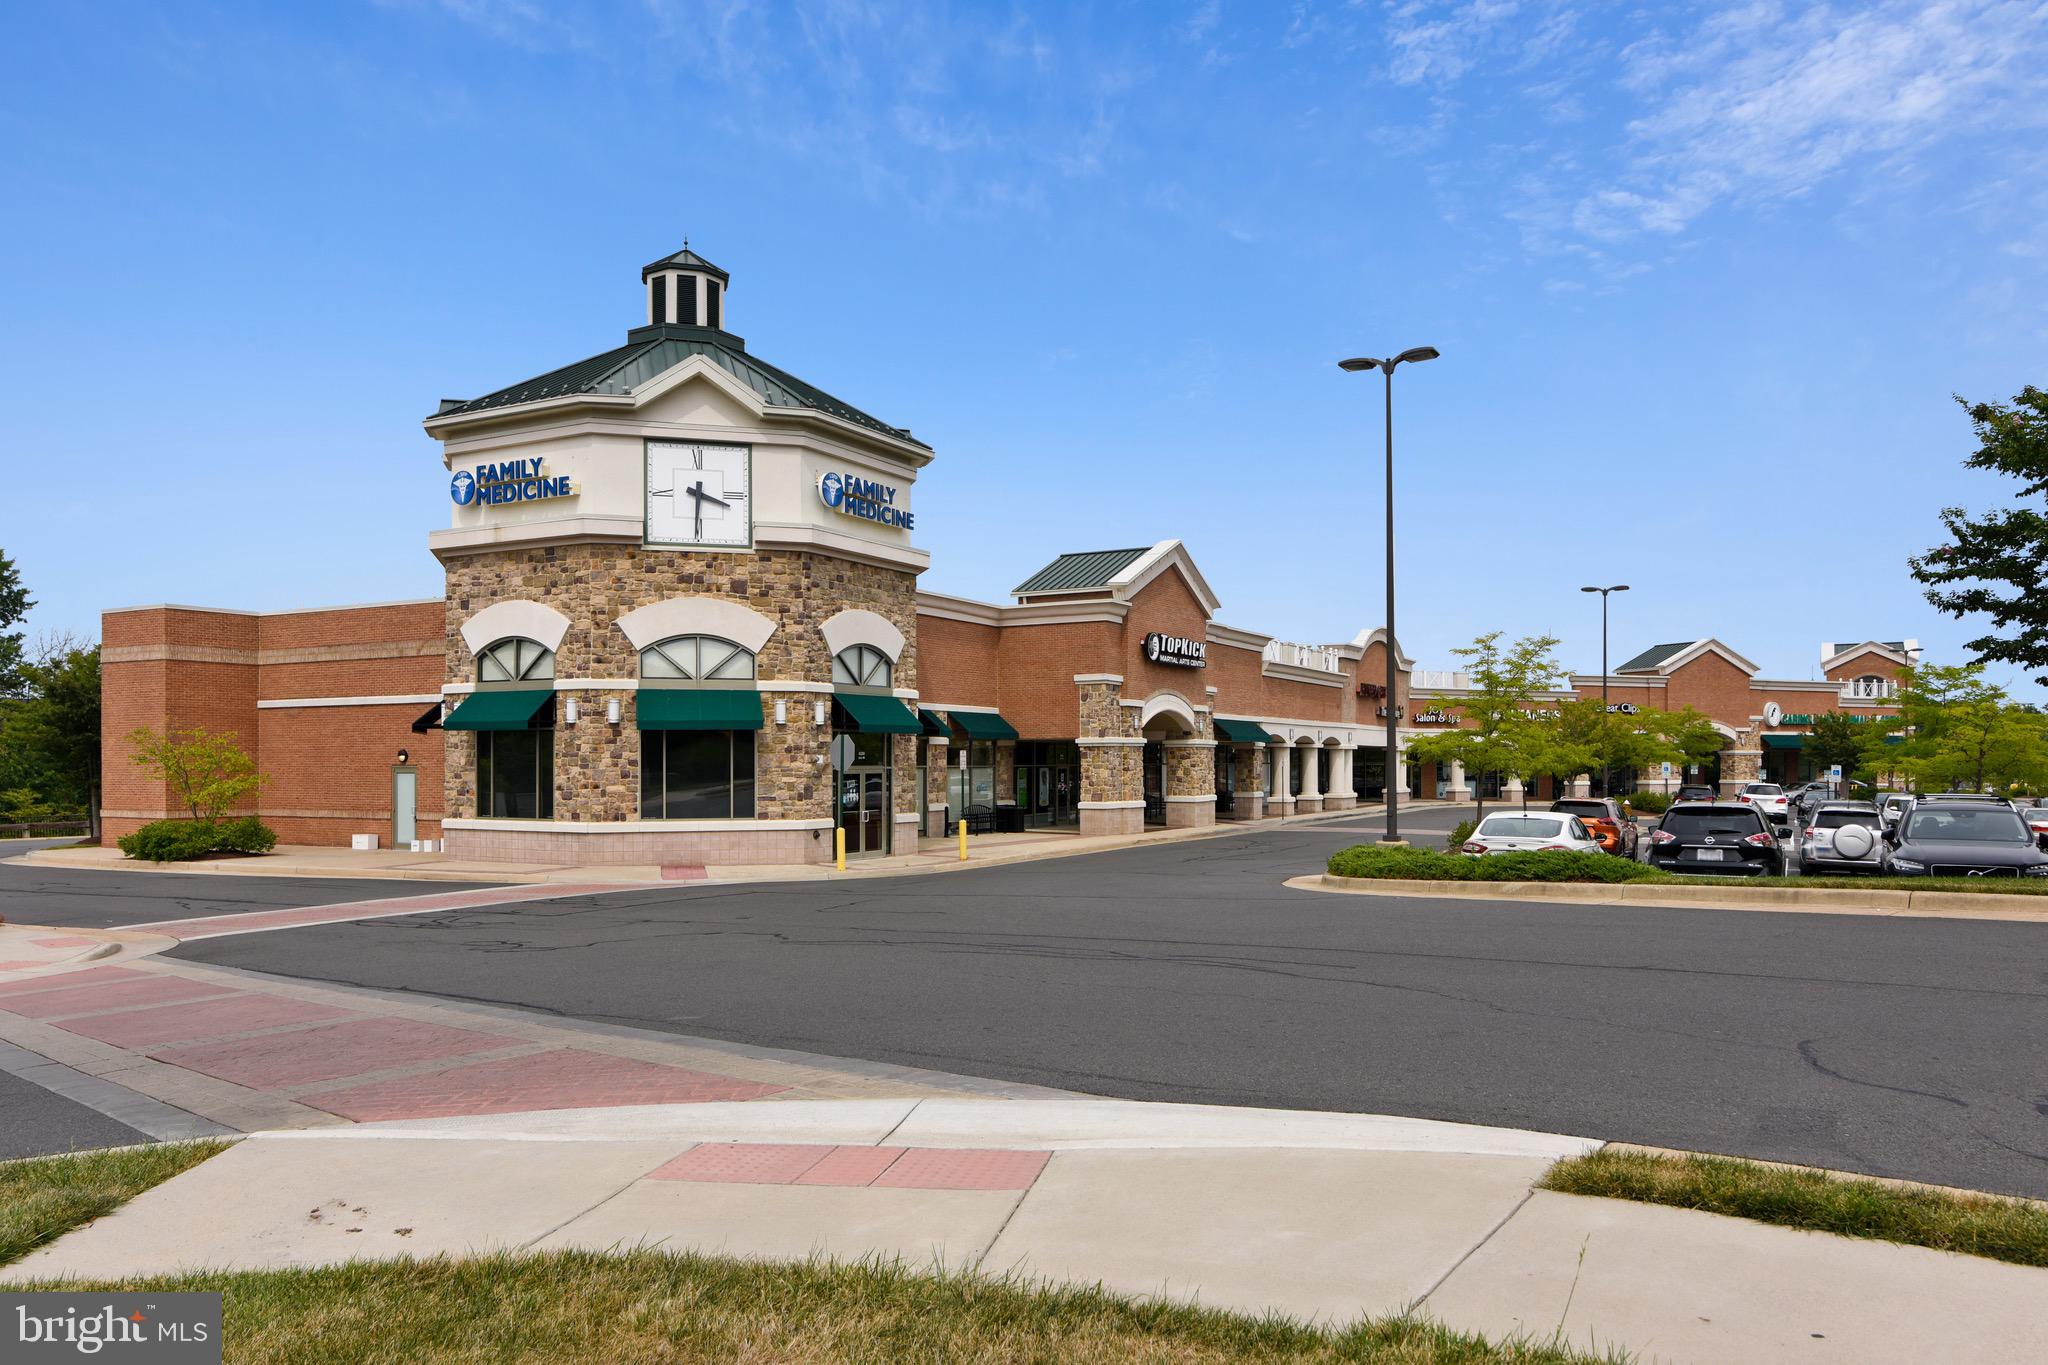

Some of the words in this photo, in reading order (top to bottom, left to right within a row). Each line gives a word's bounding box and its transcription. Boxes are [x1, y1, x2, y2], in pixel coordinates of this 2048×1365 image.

[476, 457, 543, 485] FAMILY
[476, 476, 570, 506] MEDICINE
[844, 474, 896, 505] FAMILY
[844, 495, 914, 530] MEDICINE
[1160, 654, 1179, 664] MARTIAL
[1179, 658, 1190, 666] ARTS
[1190, 659, 1206, 668] CENTER
[1415, 713, 1436, 723] Salon
[1438, 714, 1446, 723] &
